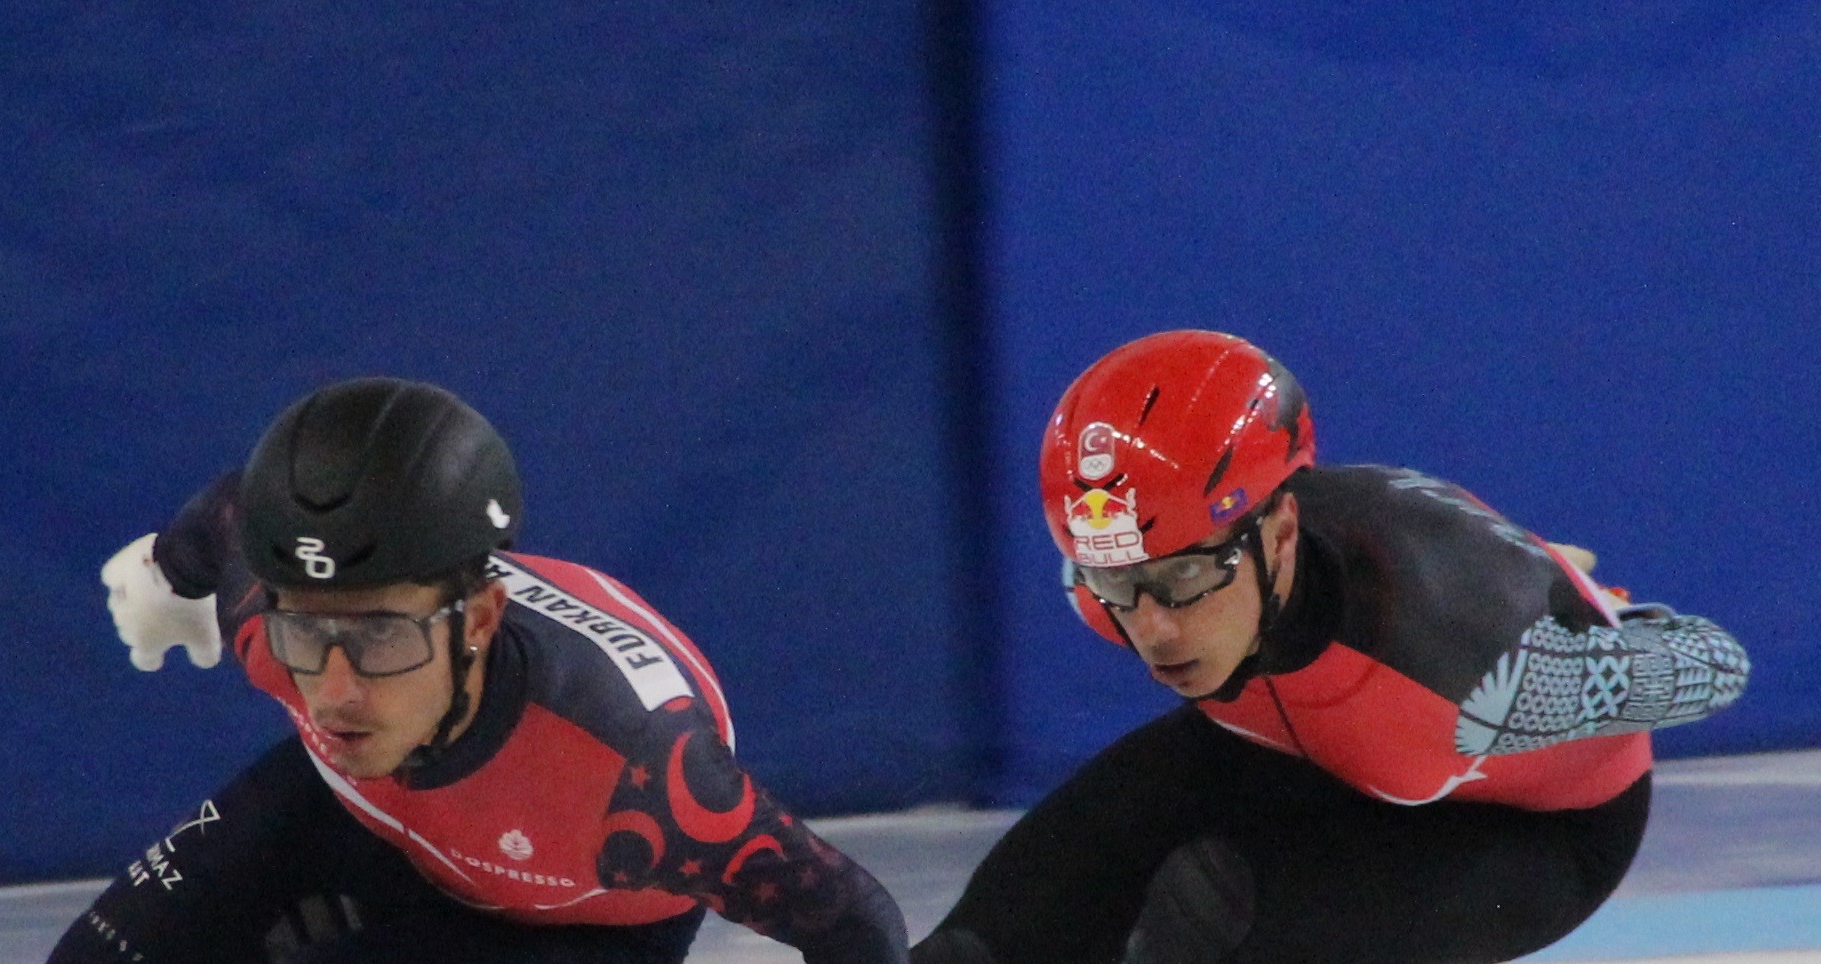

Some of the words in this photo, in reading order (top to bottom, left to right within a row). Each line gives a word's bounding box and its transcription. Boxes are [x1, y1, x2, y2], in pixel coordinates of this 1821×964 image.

[1076, 531, 1140, 551] RED
[1078, 549, 1147, 565] BULL
[513, 584, 665, 670] FURKAN
